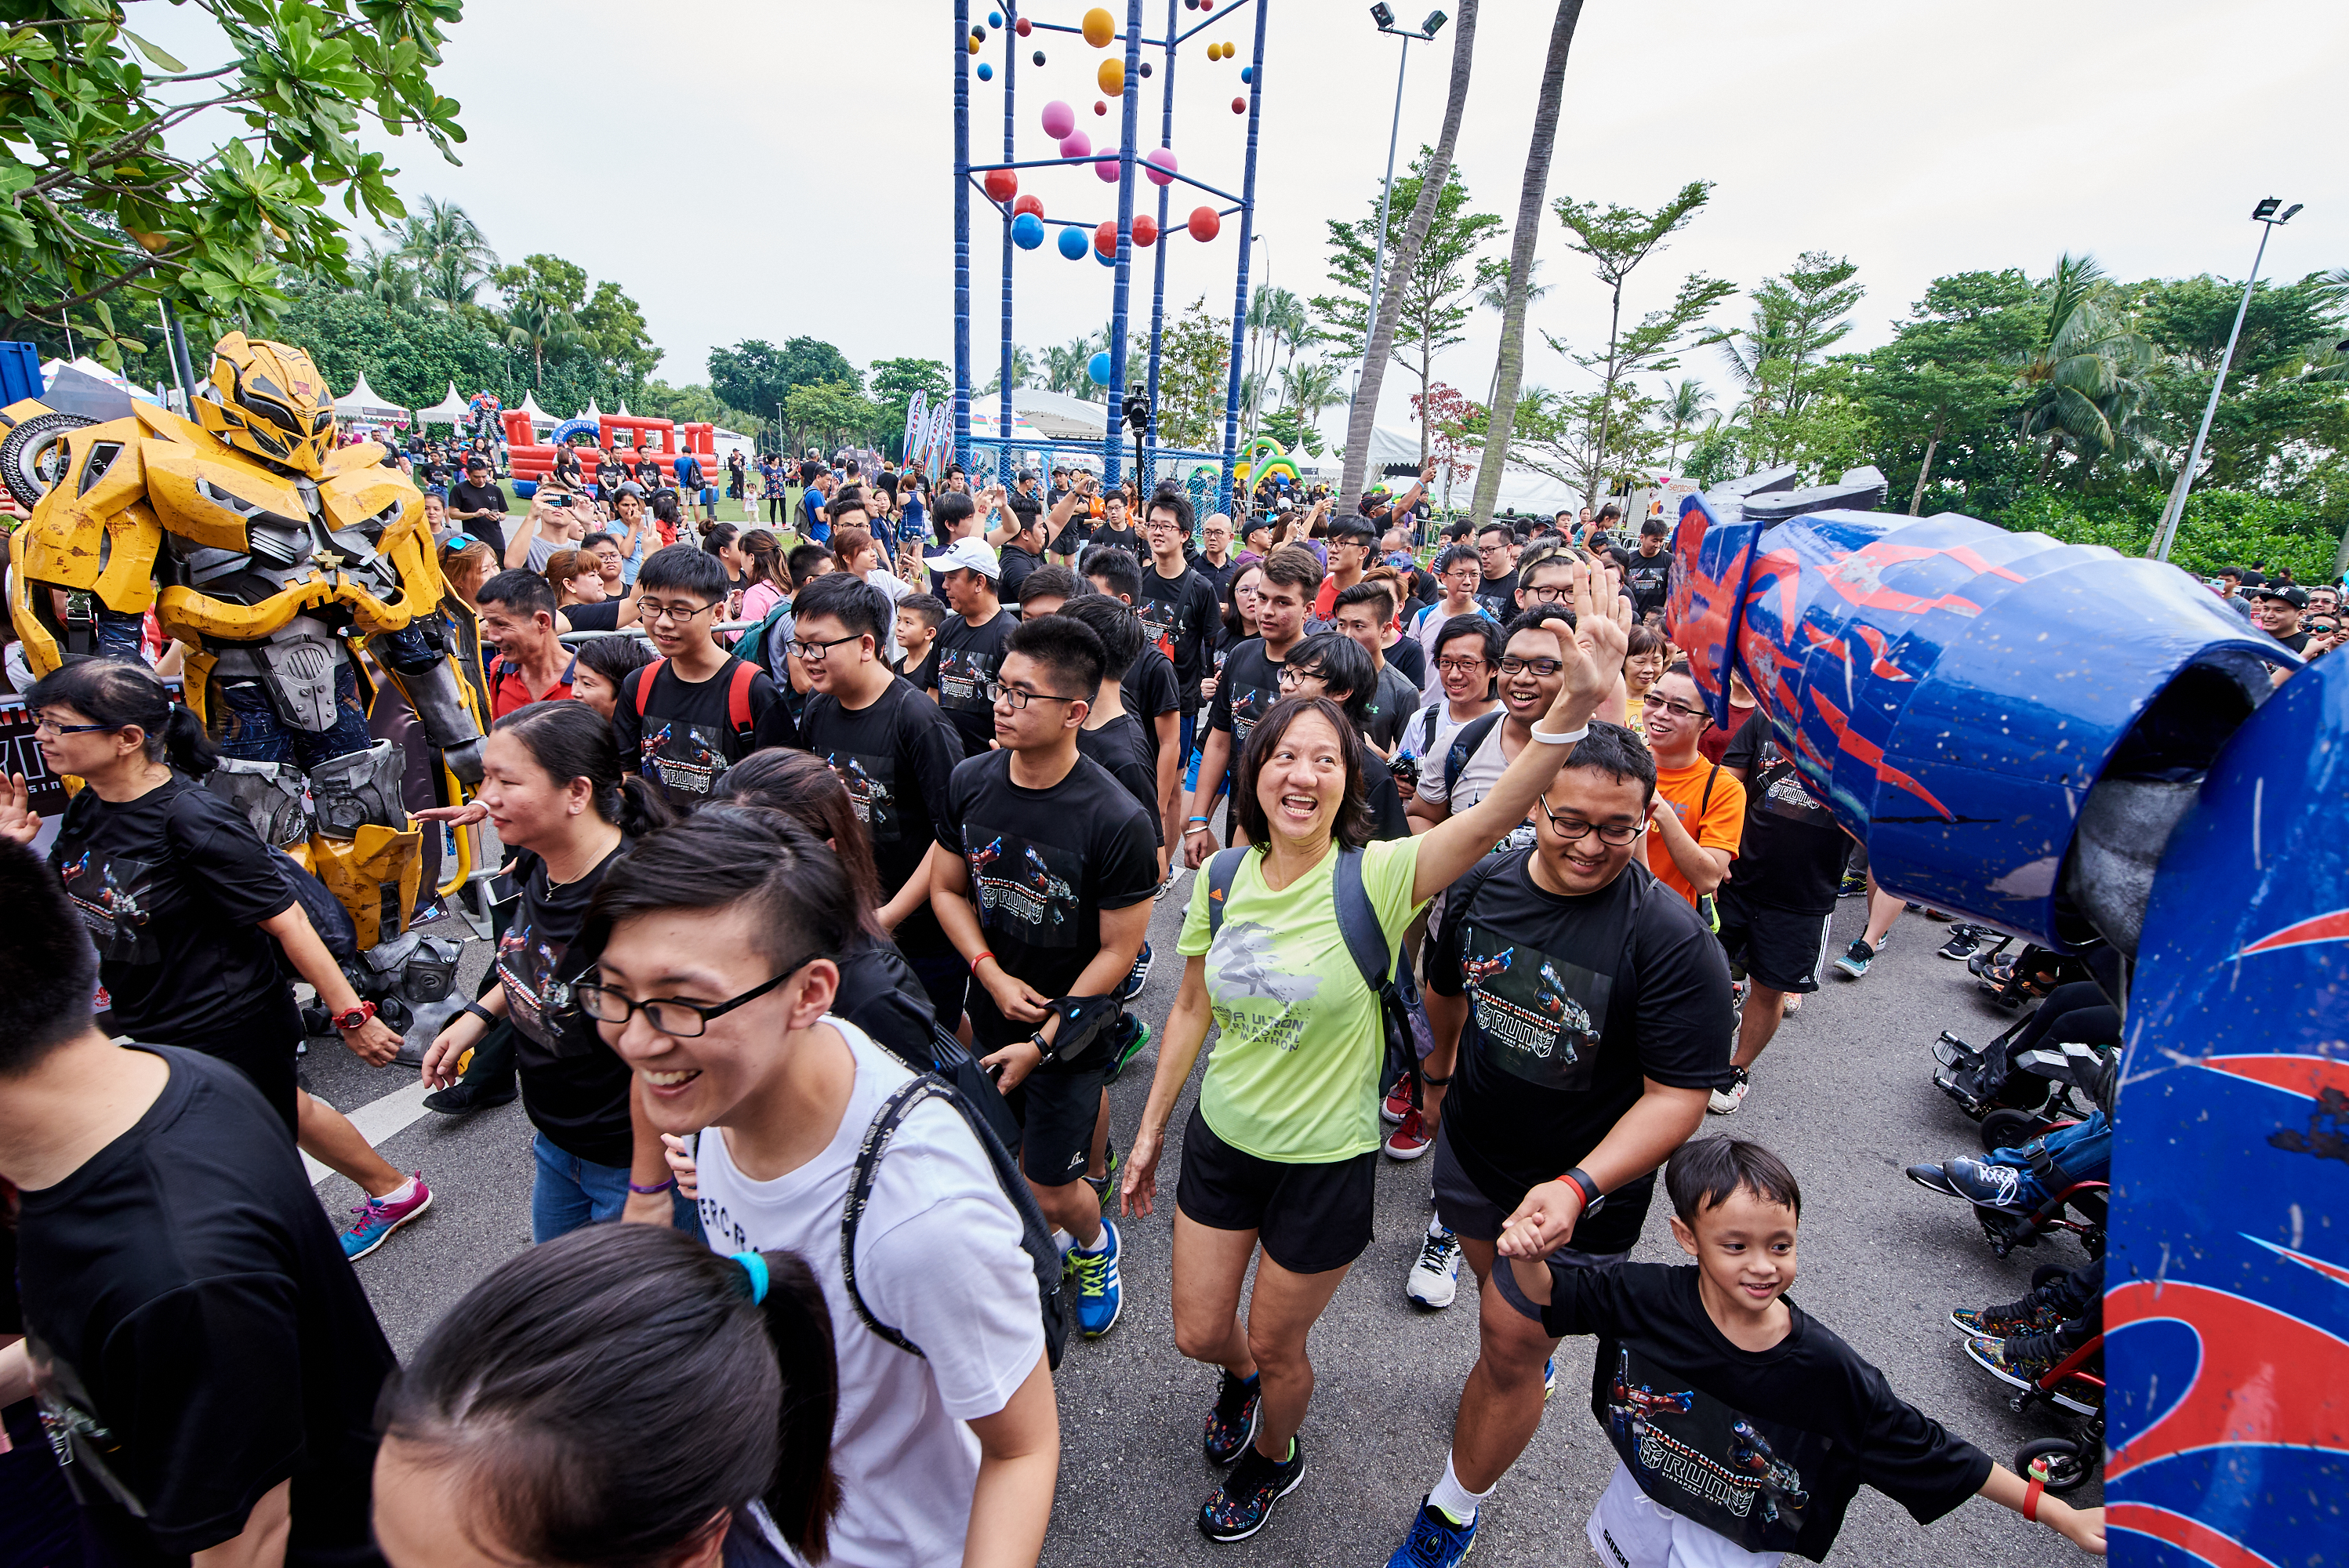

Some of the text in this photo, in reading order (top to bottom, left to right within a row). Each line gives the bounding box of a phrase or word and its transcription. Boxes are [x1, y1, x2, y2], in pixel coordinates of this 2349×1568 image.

[1668, 483, 1697, 493] Sentosa
[656, 757, 713, 775] TRANSFORMERS
[669, 769, 696, 788] RUN
[1779, 786, 1809, 804] RUN
[981, 876, 1047, 903] TRANSFORMERS
[999, 888, 1029, 916] RUN
[1478, 989, 1561, 1033] TRANSFORMERS
[1490, 1029, 1516, 1046] SINGAPORE
[1492, 1010, 1535, 1047] RUN
[1645, 1421, 1763, 1489] TRANSFORMERS
[1661, 1472, 1702, 1494] SINGAPORE
[1664, 1452, 1728, 1501] RUN
